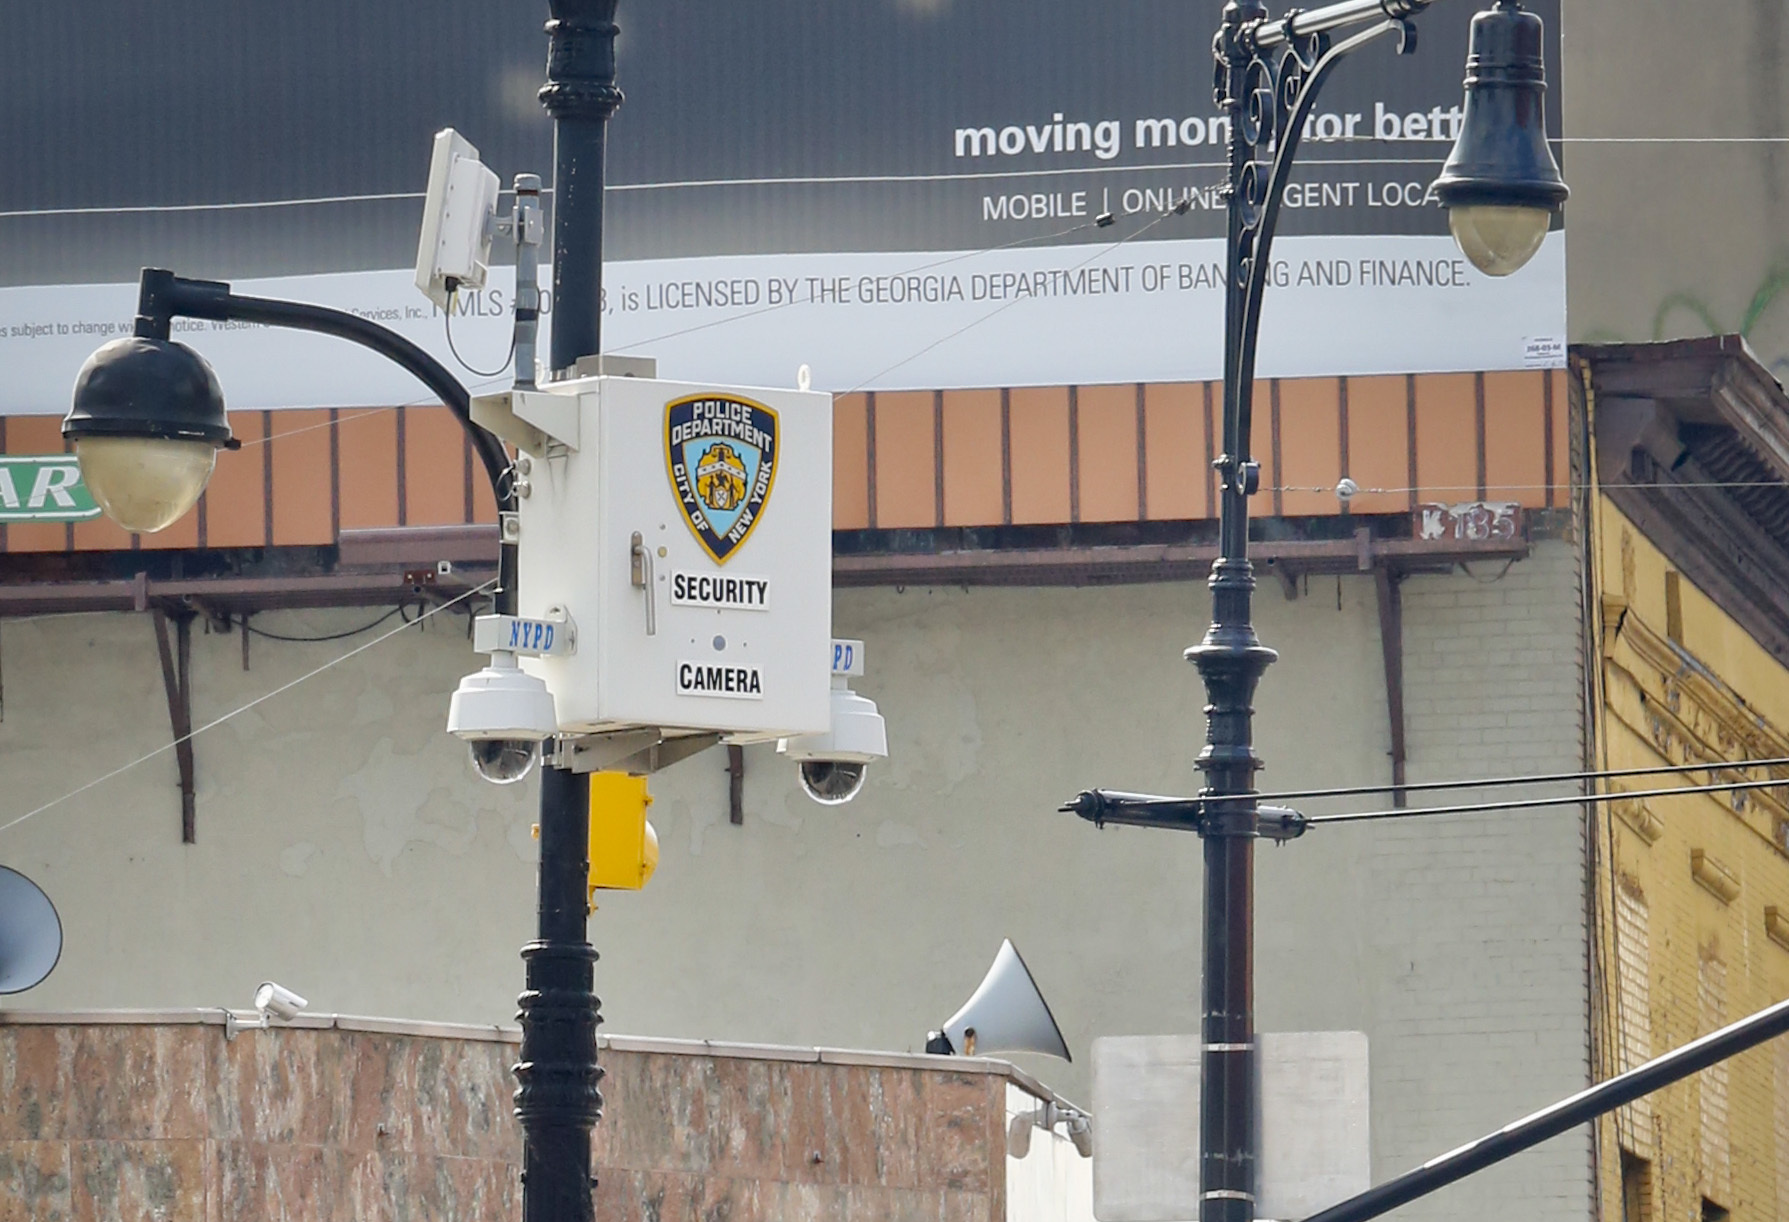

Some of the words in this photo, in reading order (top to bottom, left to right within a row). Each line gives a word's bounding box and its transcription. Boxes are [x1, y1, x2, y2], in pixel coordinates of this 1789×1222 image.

[955, 112, 1120, 160] moving
[1374, 102, 1463, 141] bett
[983, 190, 1087, 221] MOBILE
[1122, 185, 1227, 214] ONLINE
[1279, 181, 1360, 209] GENT
[1367, 182, 1441, 208] LOCA
[621, 285, 640, 311] is
[646, 279, 760, 310] LICENSED
[768, 278, 799, 304] BY
[804, 277, 850, 303] THE
[858, 275, 965, 304] GEORGIA
[972, 265, 1135, 300] DEPARTMENT
[1142, 264, 1171, 292] OF
[1179, 260, 1289, 290] BANG
[1296, 259, 1352, 286] AND
[1360, 259, 1471, 287] FINANCE.
[11, 323, 54, 338] subject
[57, 321, 72, 335] to
[72, 321, 115, 335] change
[692, 401, 753, 425] POLICE
[672, 418, 772, 452] DEPARTMENT
[673, 463, 694, 504] CITY
[690, 511, 709, 532] OF
[728, 508, 754, 544] NEW
[750, 461, 773, 504] YORK
[674, 574, 768, 604] SECURITY
[509, 620, 554, 650] NYPD
[833, 644, 853, 671] PD
[680, 663, 761, 694] CAMERA
